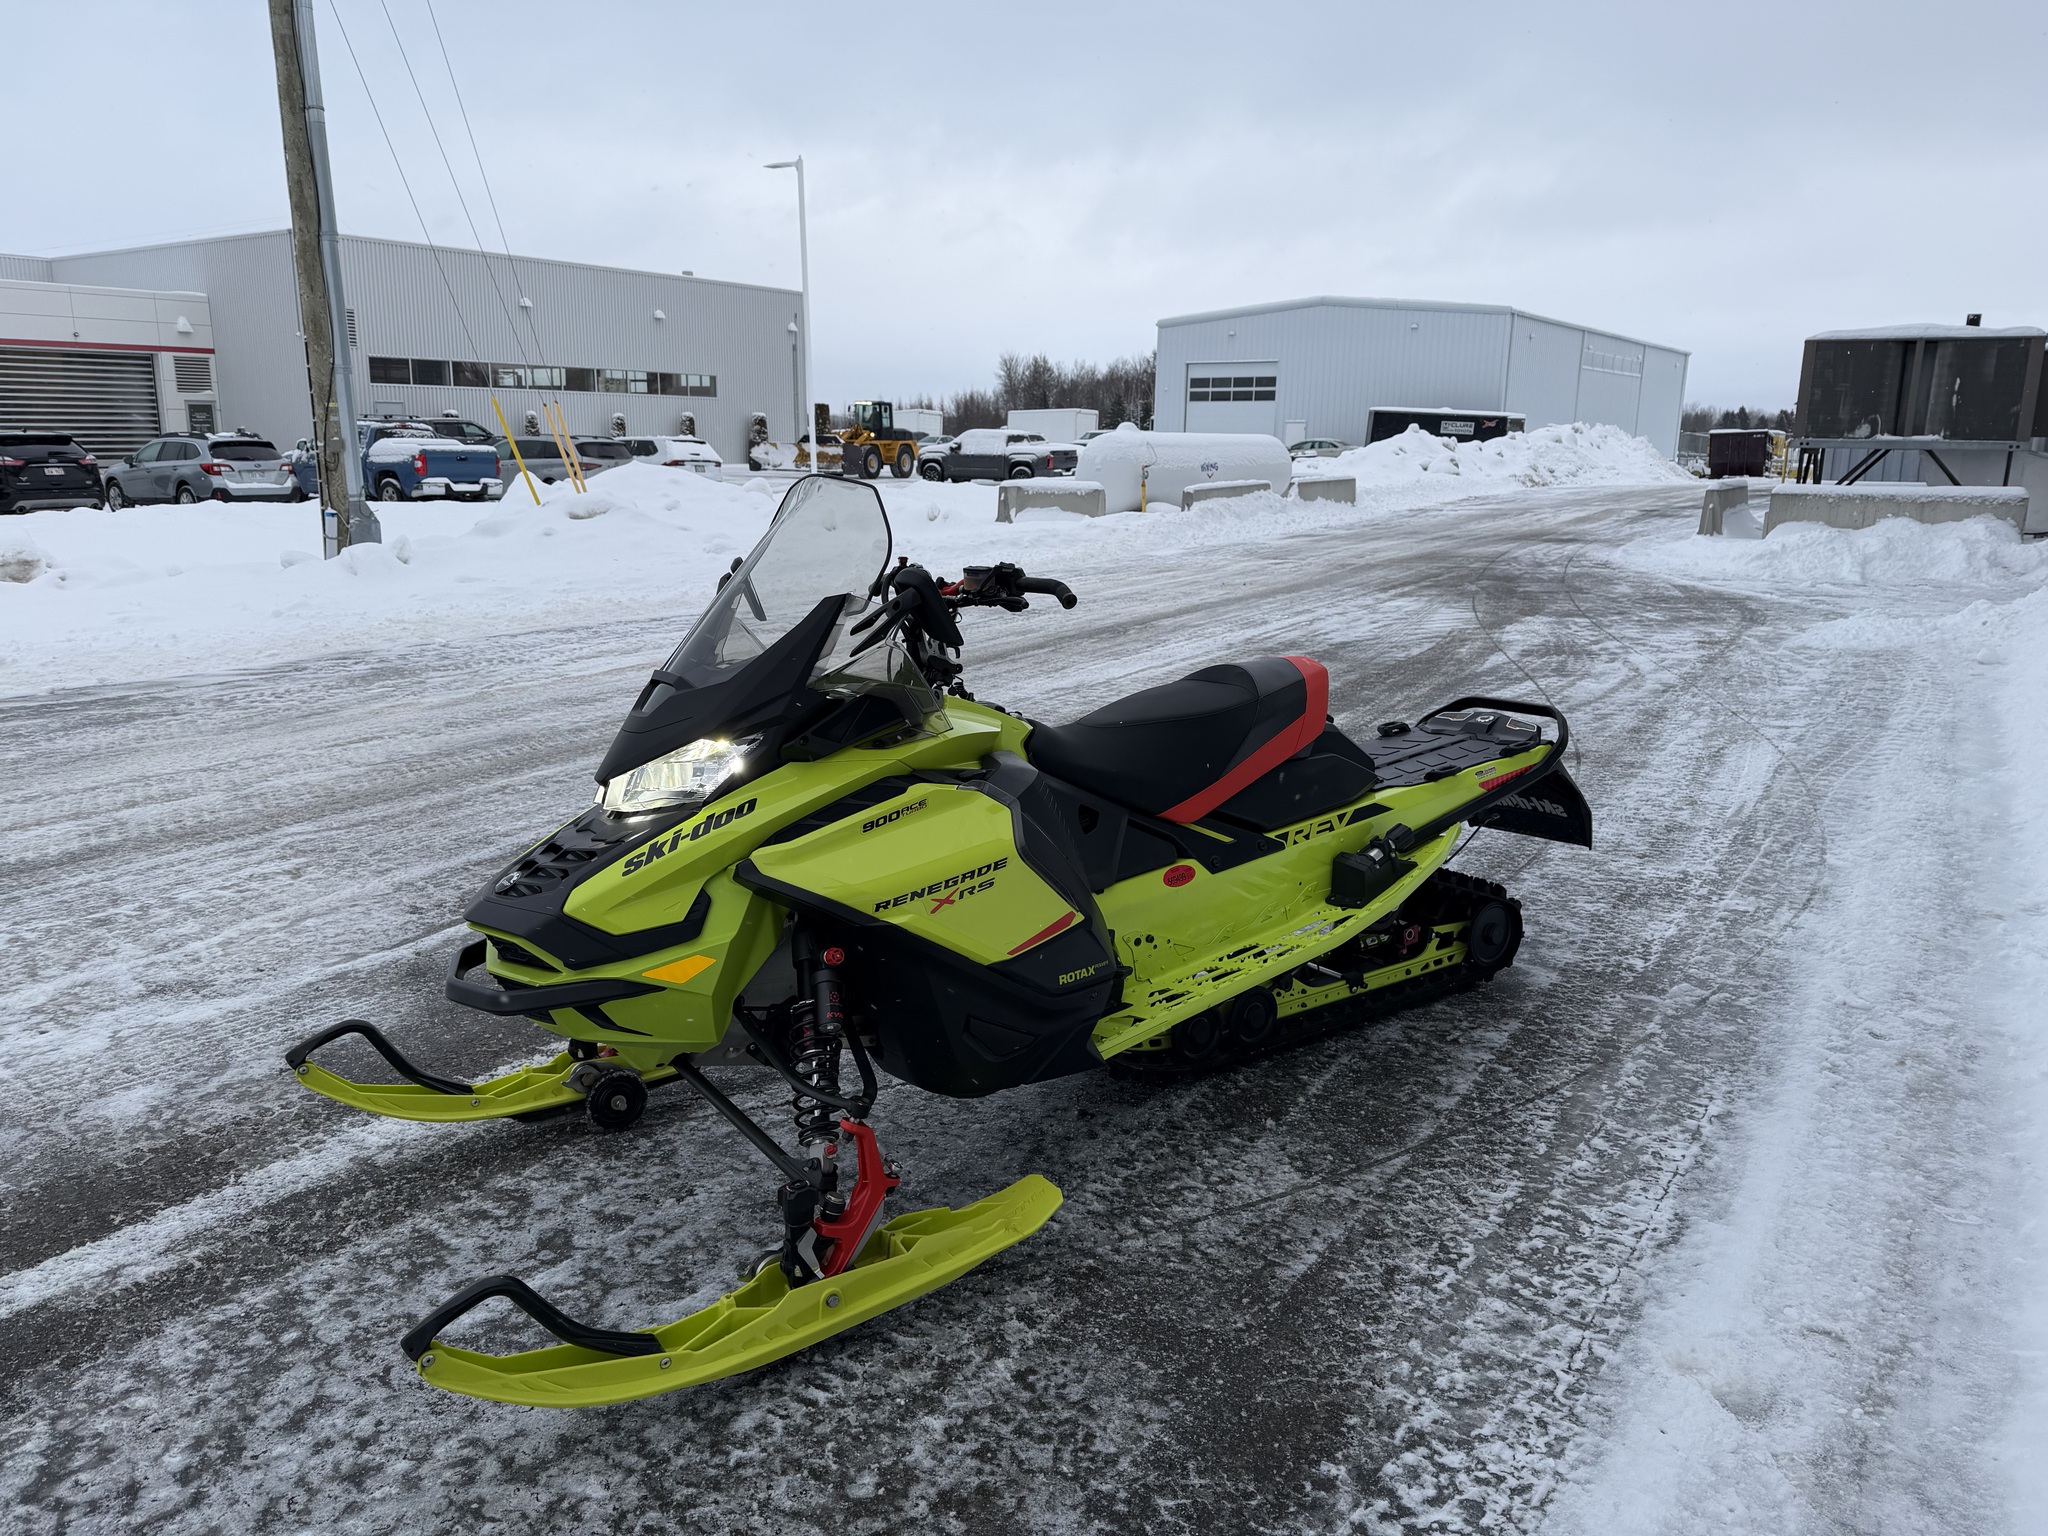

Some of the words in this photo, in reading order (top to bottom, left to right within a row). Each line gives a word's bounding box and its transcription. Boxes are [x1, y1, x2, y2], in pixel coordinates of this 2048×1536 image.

[862, 809, 901, 834] 900
[901, 798, 928, 814] ACE
[1286, 809, 1355, 848] REV
[874, 857, 1008, 913] RENEGADE
[930, 877, 995, 914] XRS
[1058, 965, 1095, 986] ROTAX
